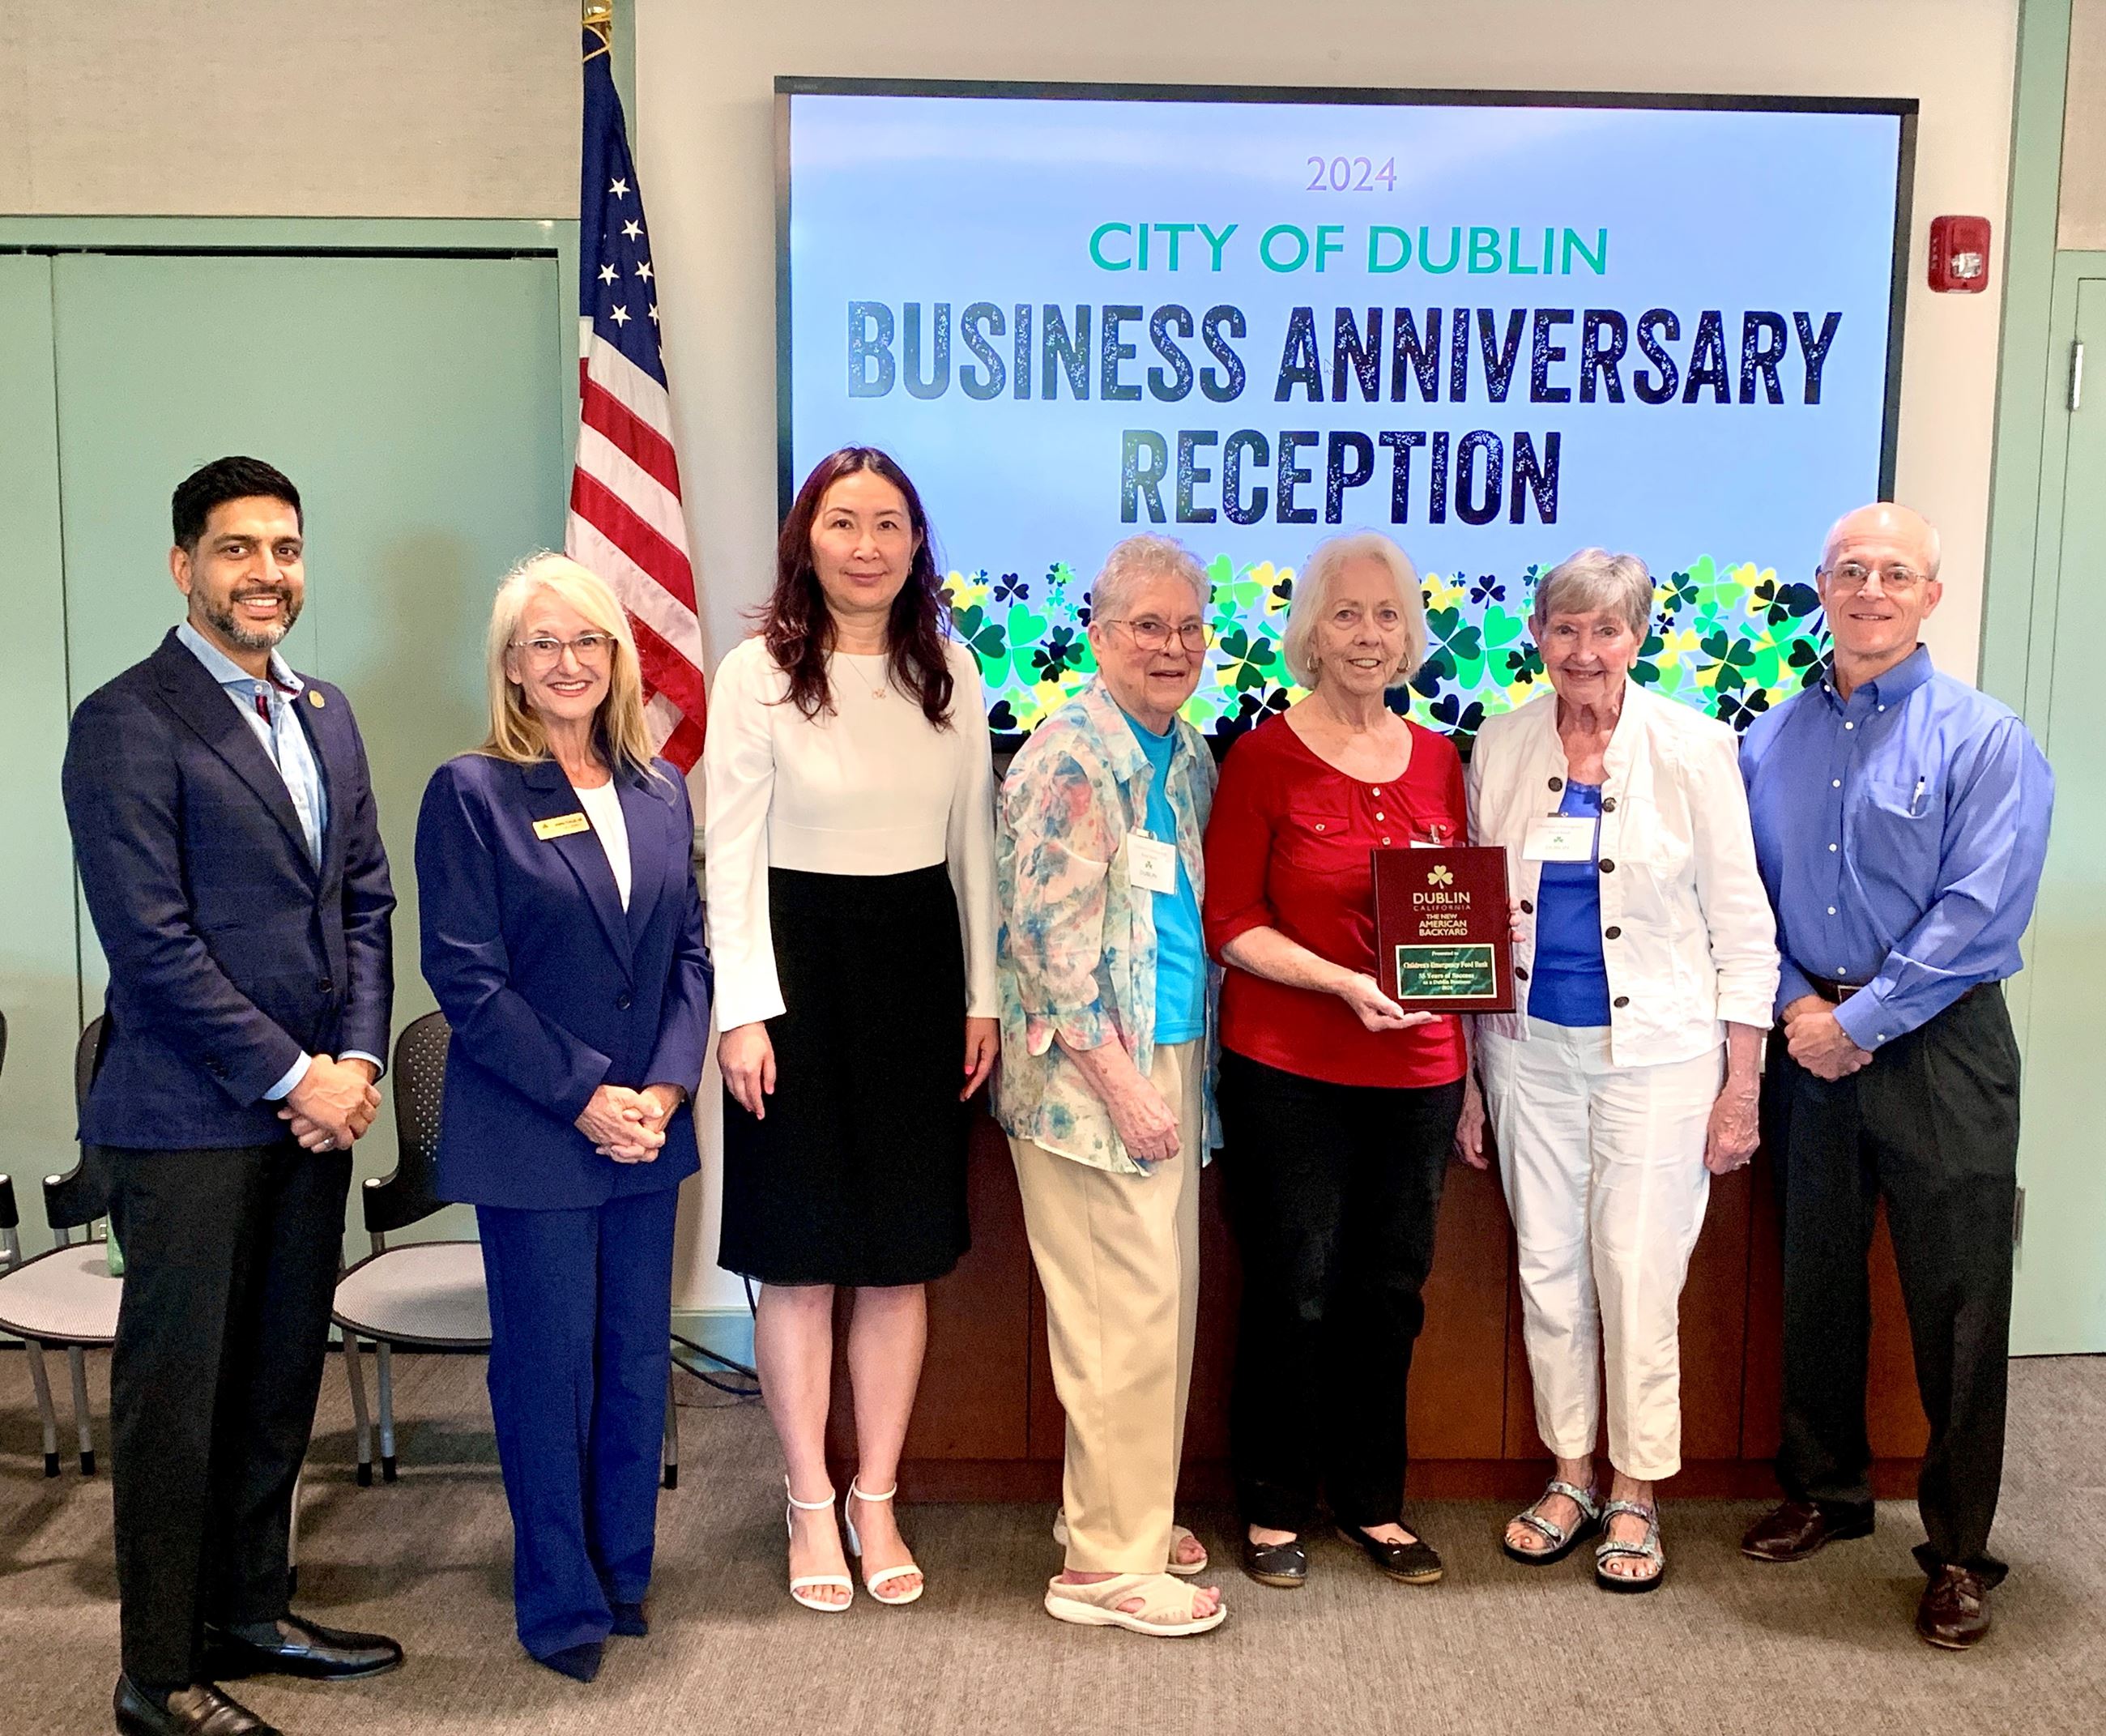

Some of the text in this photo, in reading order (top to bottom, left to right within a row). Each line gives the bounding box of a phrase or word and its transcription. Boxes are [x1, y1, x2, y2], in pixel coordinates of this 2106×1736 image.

[1306, 156, 1398, 193] 2024
[1089, 222, 1608, 276] CITY OF DUBLIN
[846, 301, 1843, 406] BUSINESS ANNIVERSARY
[1120, 429, 1562, 527] RECEPTION
[1413, 892, 1470, 904] DUBLIN
[1419, 919, 1467, 928] AMERICAN
[1430, 962, 1460, 970] Emergency
